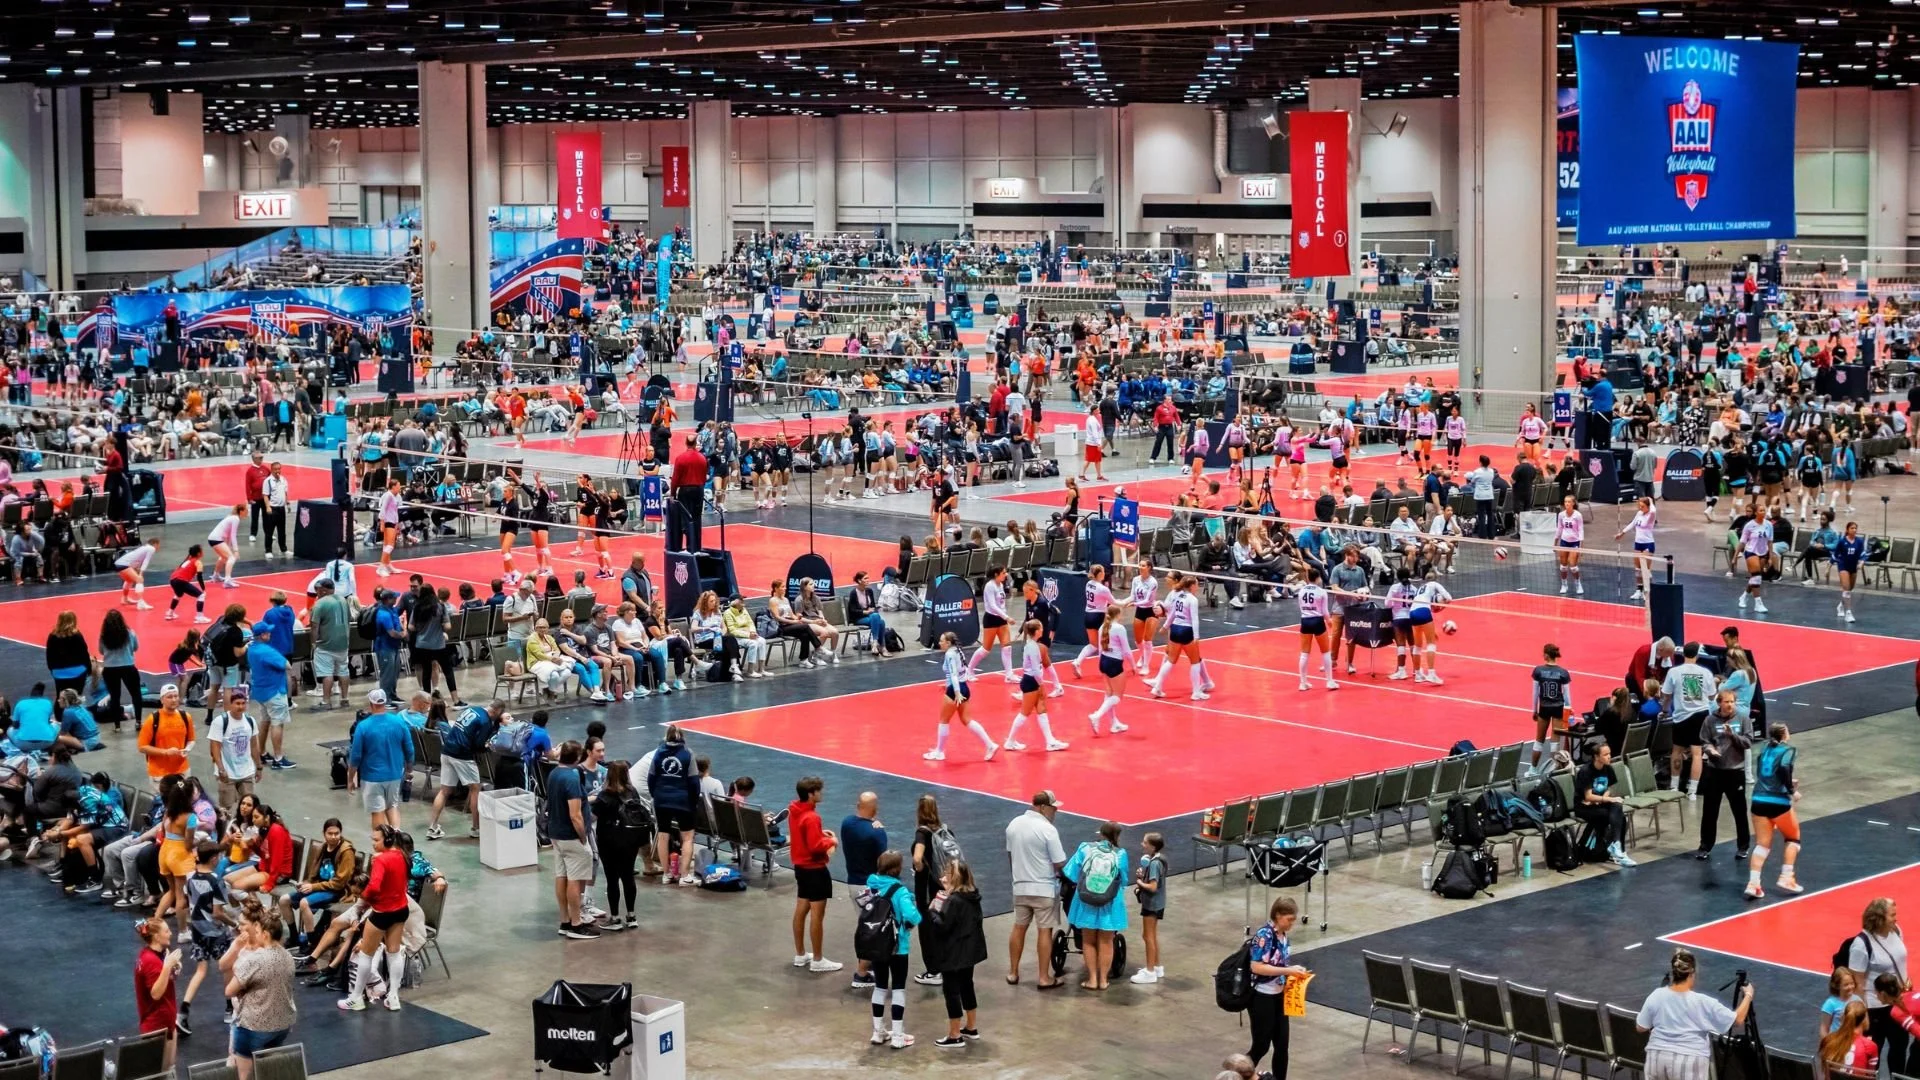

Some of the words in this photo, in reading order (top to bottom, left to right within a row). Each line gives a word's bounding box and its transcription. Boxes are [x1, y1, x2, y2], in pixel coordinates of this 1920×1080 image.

[1644, 46, 1740, 77] WELCOME
[1675, 121, 1709, 145] AAU
[1557, 131, 1580, 152] RT
[1666, 154, 1717, 175] Volleyball
[575, 151, 584, 212] MEDICAL
[1560, 162, 1580, 188] 52
[1246, 183, 1273, 196] EXIT
[1315, 142, 1325, 237] MEDICAL
[243, 198, 287, 216] EXIT
[1060, 223, 1090, 231] Restrooms
[1608, 226, 1623, 235] AAU
[1624, 225, 1649, 234] JUNIOR
[1650, 223, 1682, 233] NATIONAL
[1684, 221, 1724, 231] VOLLEYBALL
[1725, 220, 1771, 230] CHAMPIONSHIP
[535, 277, 556, 285] AAU
[534, 291, 555, 312] USA
[257, 316, 282, 336] USA
[1555, 409, 1570, 418] 123
[646, 499, 660, 509] 124
[1115, 522, 1135, 536] 125
[789, 577, 819, 587] BAR
[1302, 592, 1315, 604] 46
[934, 601, 962, 612] BALLER
[1543, 681, 1559, 699] 18
[547, 1027, 596, 1041] molten
